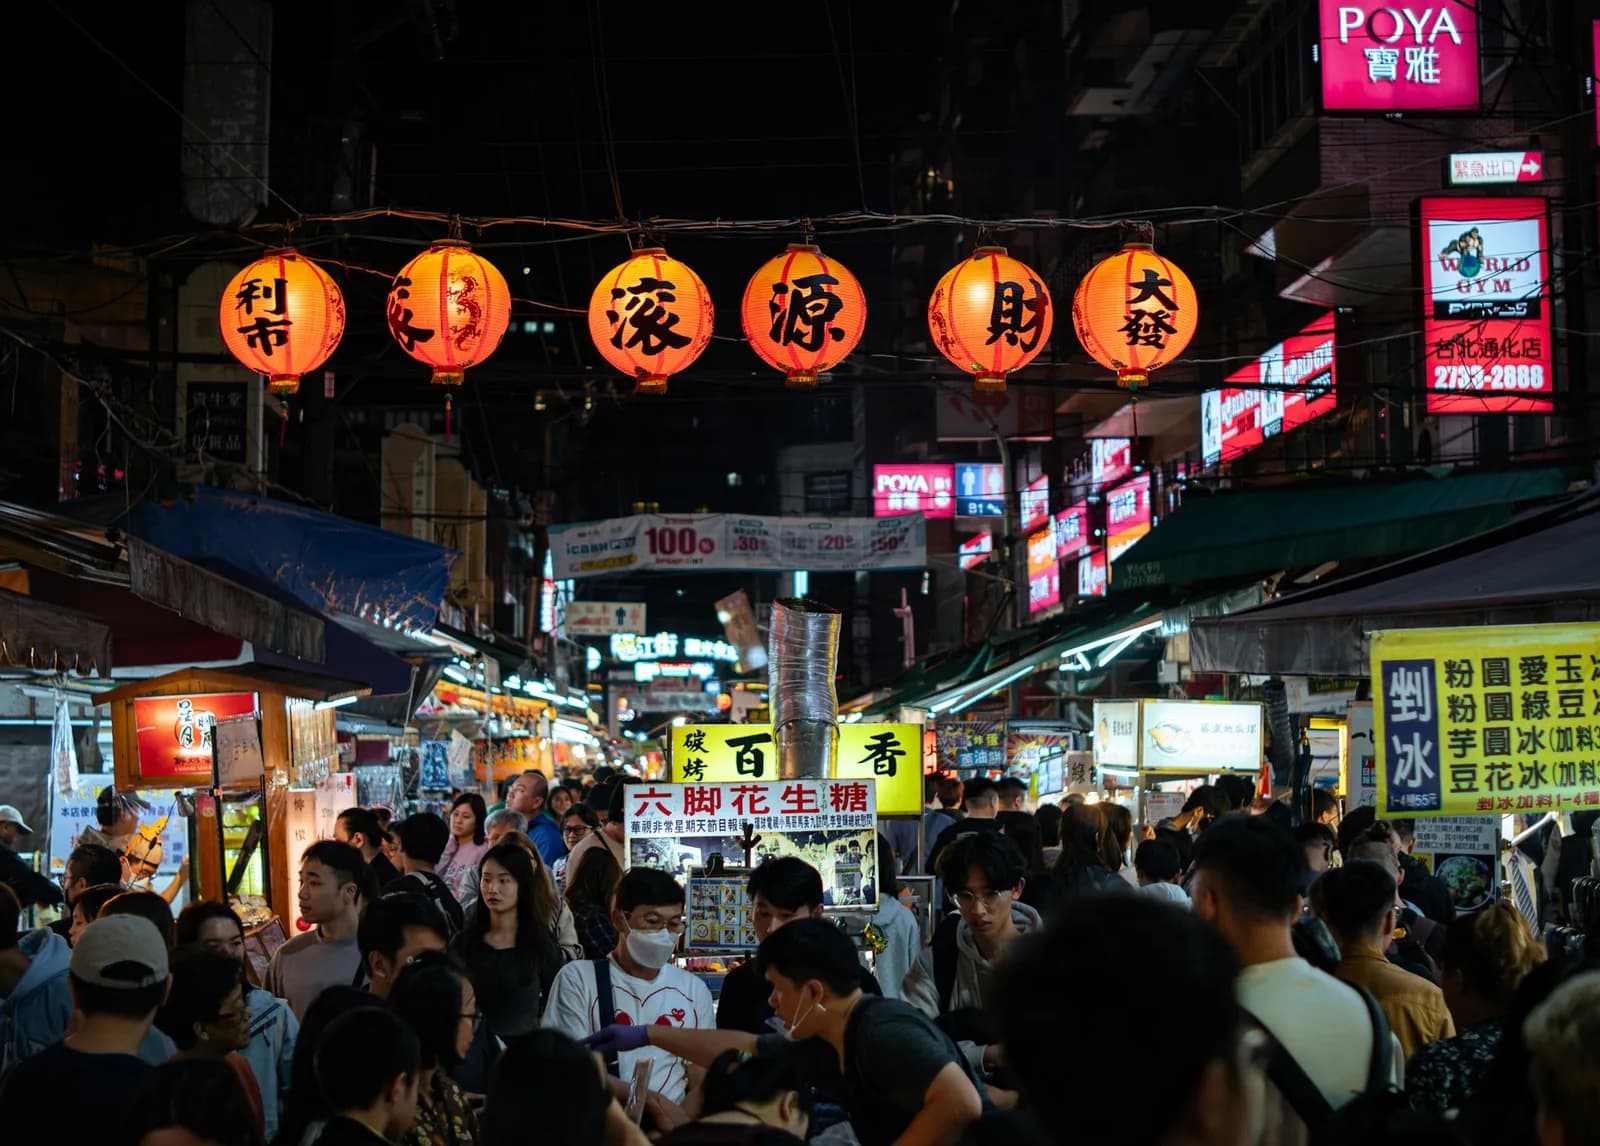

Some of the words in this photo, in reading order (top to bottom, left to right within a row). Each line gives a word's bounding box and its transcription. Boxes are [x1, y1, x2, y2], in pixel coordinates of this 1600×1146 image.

[1337, 7, 1462, 45] POYA
[1364, 47, 1441, 84] 寶雅
[1455, 159, 1515, 177] 緊急出口
[1457, 278, 1512, 294] GYM
[235, 277, 293, 356] 利市
[606, 277, 693, 355] 滾
[768, 273, 845, 352] 源
[985, 278, 1049, 353] 財
[1117, 269, 1180, 349] 大發
[1436, 338, 1542, 359] 台北通化店
[1434, 364, 1545, 390] 2733-2888
[877, 474, 928, 492] POYA
[968, 503, 983, 514] B1
[645, 527, 697, 554] 100
[1389, 667, 1435, 788] 剉冰
[682, 729, 709, 781] 碳烤
